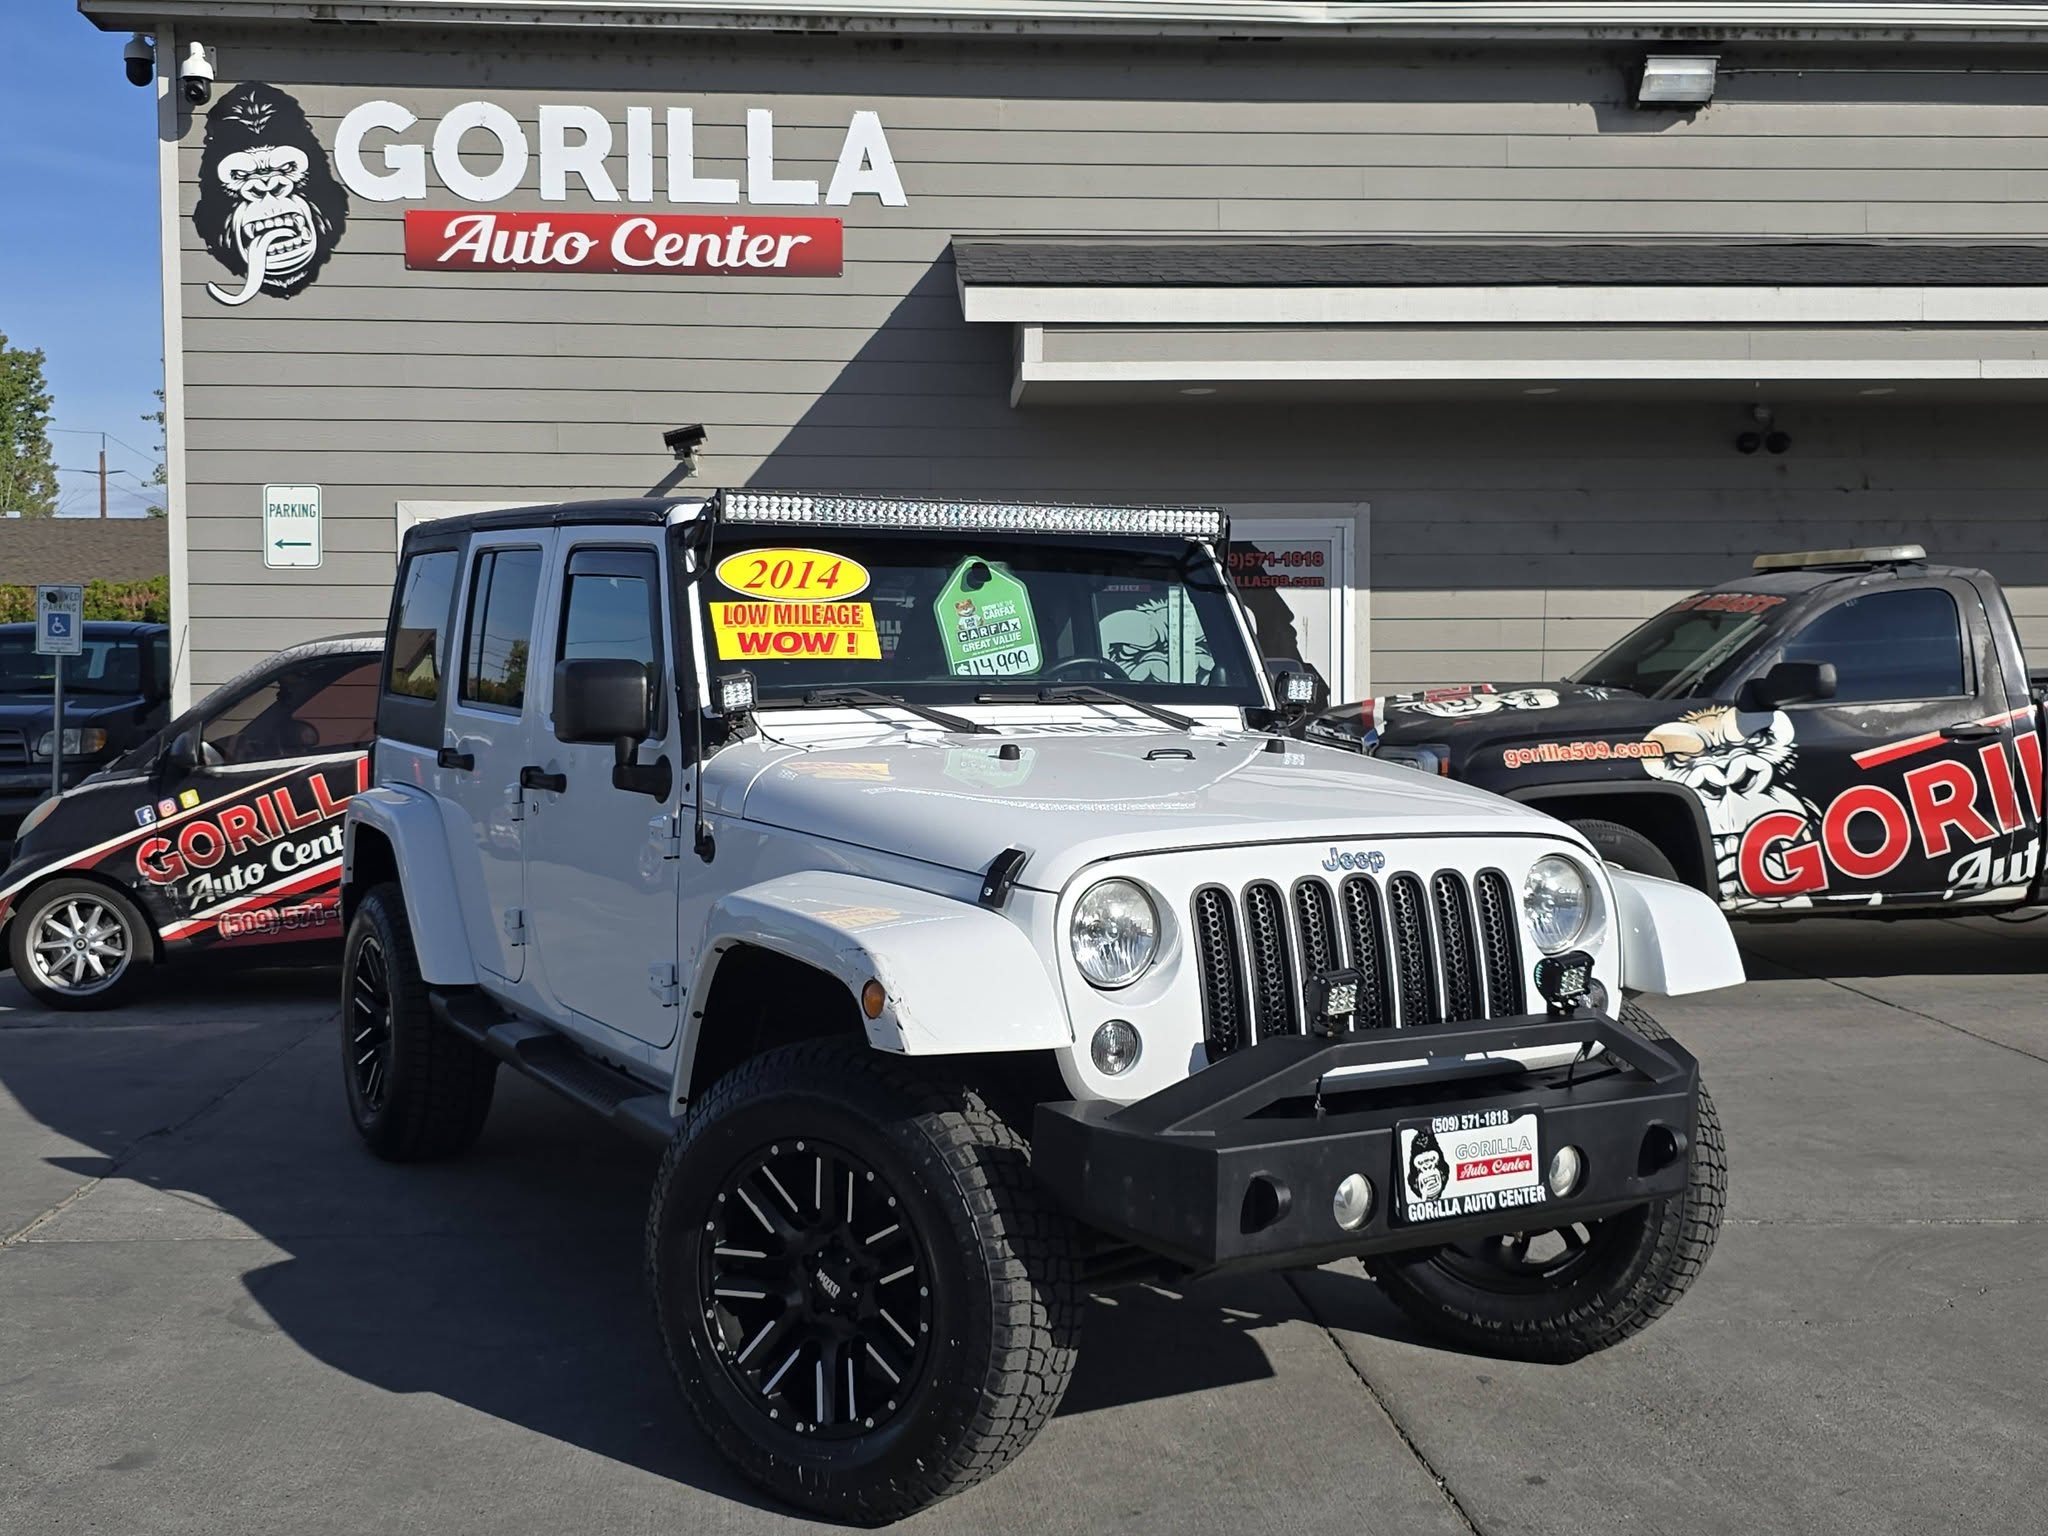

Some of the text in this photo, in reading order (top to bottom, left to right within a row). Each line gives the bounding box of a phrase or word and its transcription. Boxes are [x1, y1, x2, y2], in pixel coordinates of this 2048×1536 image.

[334, 100, 908, 207] GORILLA
[437, 214, 812, 269] Auto Center
[269, 503, 317, 518] PARKING
[743, 559, 842, 590] 2014
[42, 602, 77, 613] PARKING
[723, 604, 864, 628] LOW MILEAGE
[983, 604, 1016, 620] CARFAX
[958, 620, 1020, 642] CARFAX
[962, 638, 992, 653] GREAT
[993, 632, 1022, 646] VALUE
[737, 632, 839, 656] WOW
[846, 632, 858, 656] !
[1503, 741, 1664, 768] gorilla509.com
[1322, 847, 1386, 873] Jeep
[187, 861, 267, 910] Auto
[1432, 1109, 1509, 1133] (509) 571-1818
[1455, 1136, 1532, 1160] GORILLA
[1459, 1157, 1531, 1179] Auto Center
[1407, 1185, 1546, 1222] GORILLA AUTO CENTER
